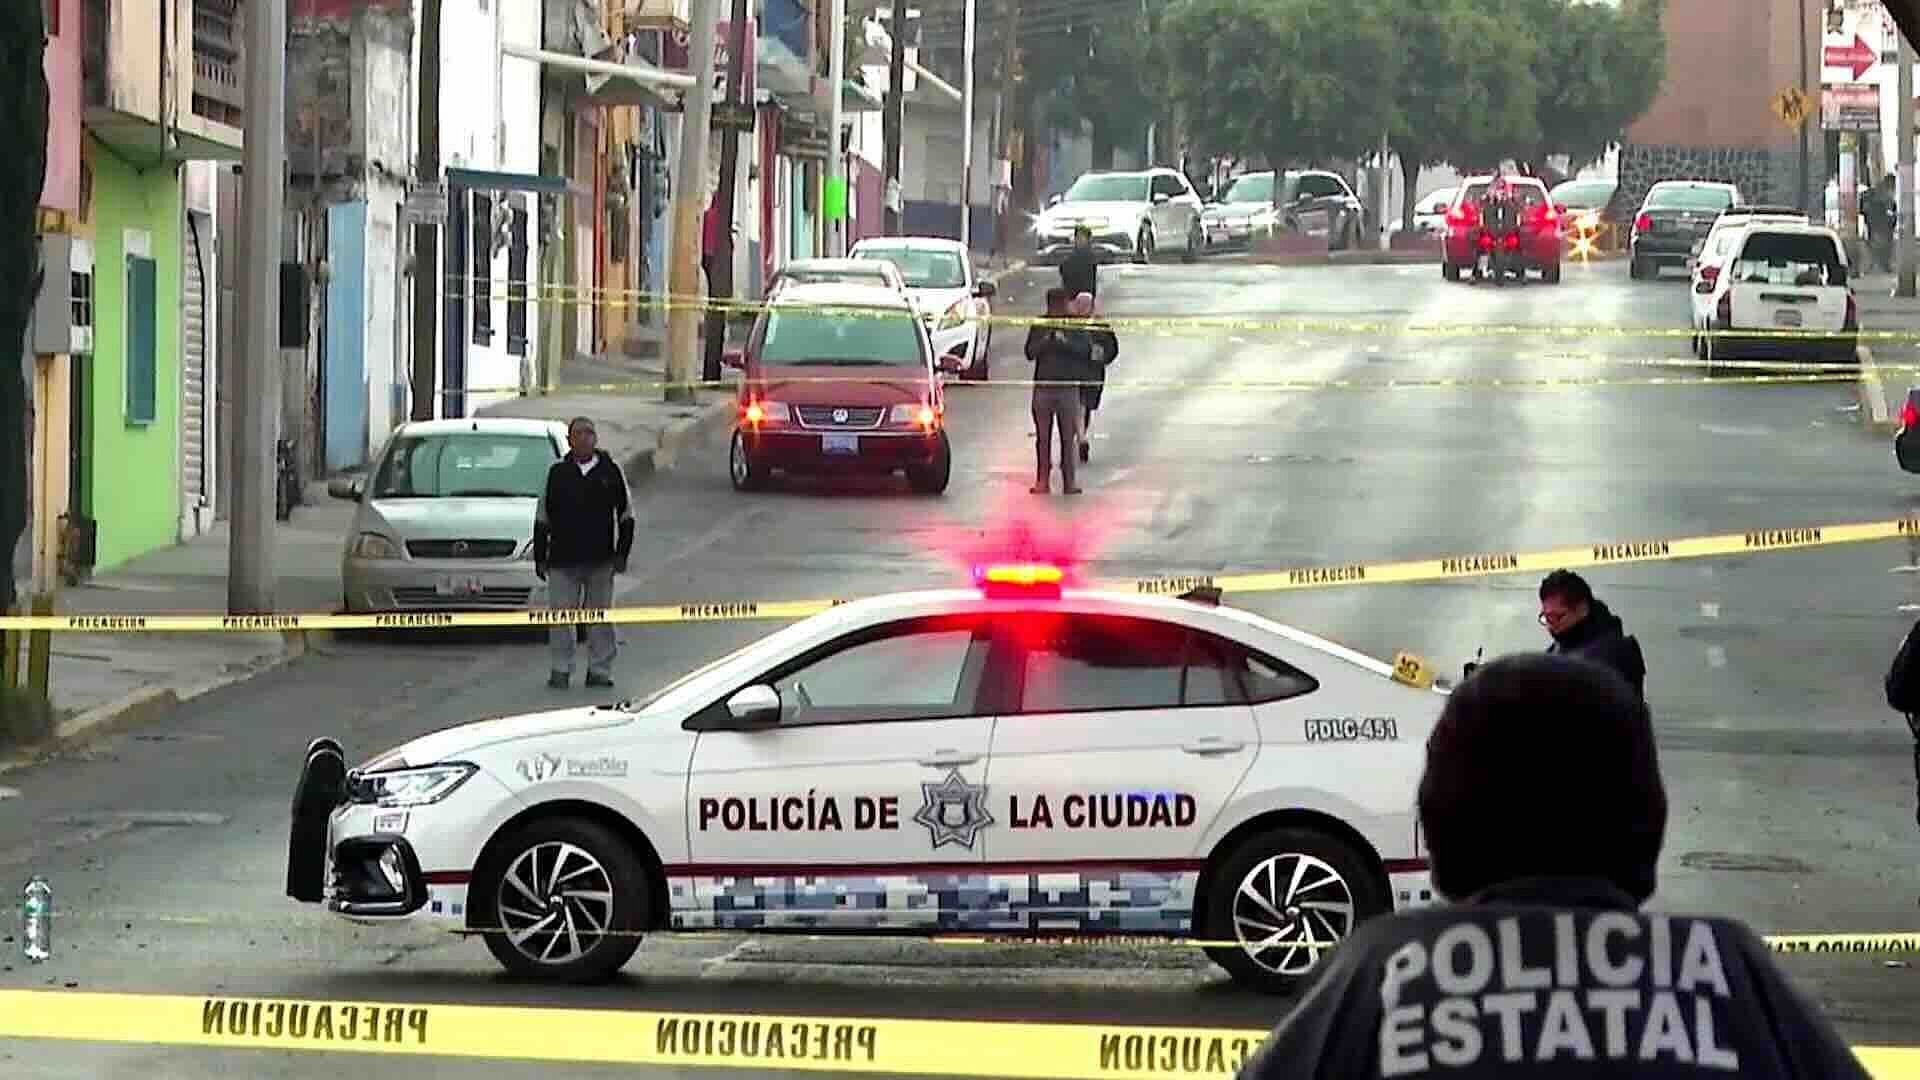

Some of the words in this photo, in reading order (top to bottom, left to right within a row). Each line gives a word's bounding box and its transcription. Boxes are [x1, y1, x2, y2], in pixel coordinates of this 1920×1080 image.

[1289, 567, 1365, 584] PRECAUCION
[1442, 555, 1517, 573] PRECAUCION
[1593, 541, 1669, 560] PRECAUCION
[1745, 528, 1821, 546] PRECAUCION
[699, 789, 842, 831] POLICÍA
[854, 797, 899, 831] DE
[1009, 795, 1054, 829] LA
[1063, 794, 1196, 829] CIUDAD
[1380, 912, 1731, 1008] POLICIA
[1379, 987, 1740, 1078] ESTATAL
